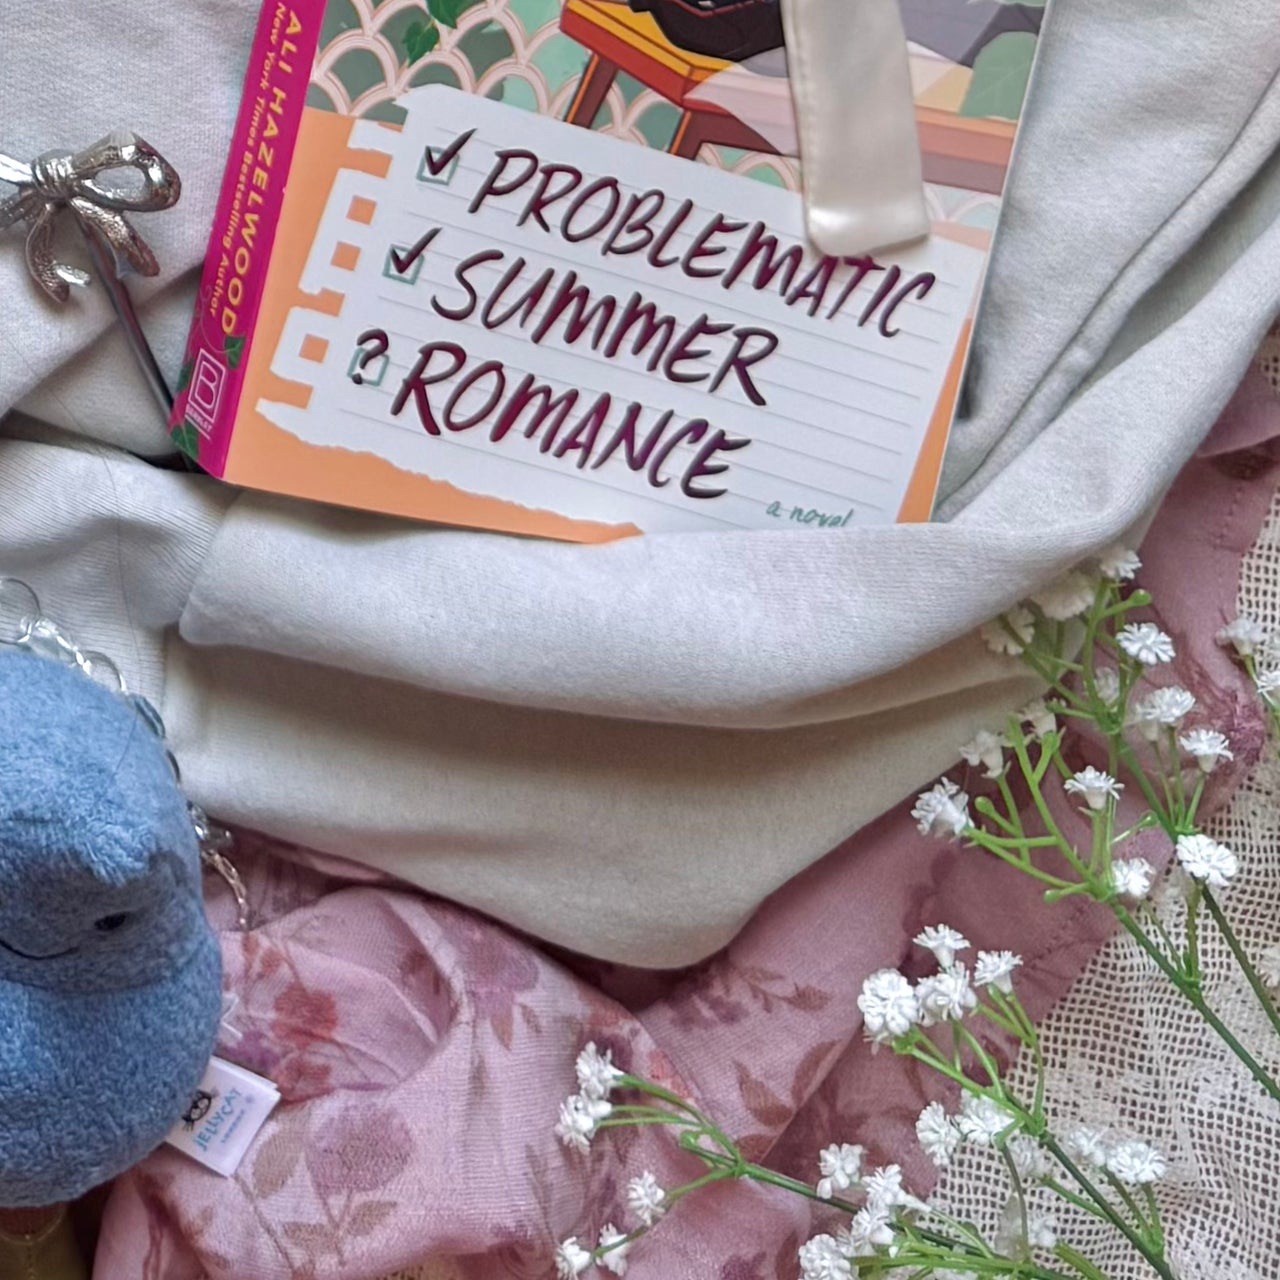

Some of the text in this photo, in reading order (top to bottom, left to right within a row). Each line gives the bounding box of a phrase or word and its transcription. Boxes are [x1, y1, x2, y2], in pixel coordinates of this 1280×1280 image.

[209, 1, 286, 318] New York Times Bestselling Author
[221, 9, 302, 335] ALI HAZELWOOD
[467, 148, 937, 339] PROBLEMATIC
[430, 248, 780, 407] SUMMER
[390, 341, 753, 500] ROMANCE
[765, 500, 855, 528] a novel
[193, 1087, 242, 1152] JELLYCAT
